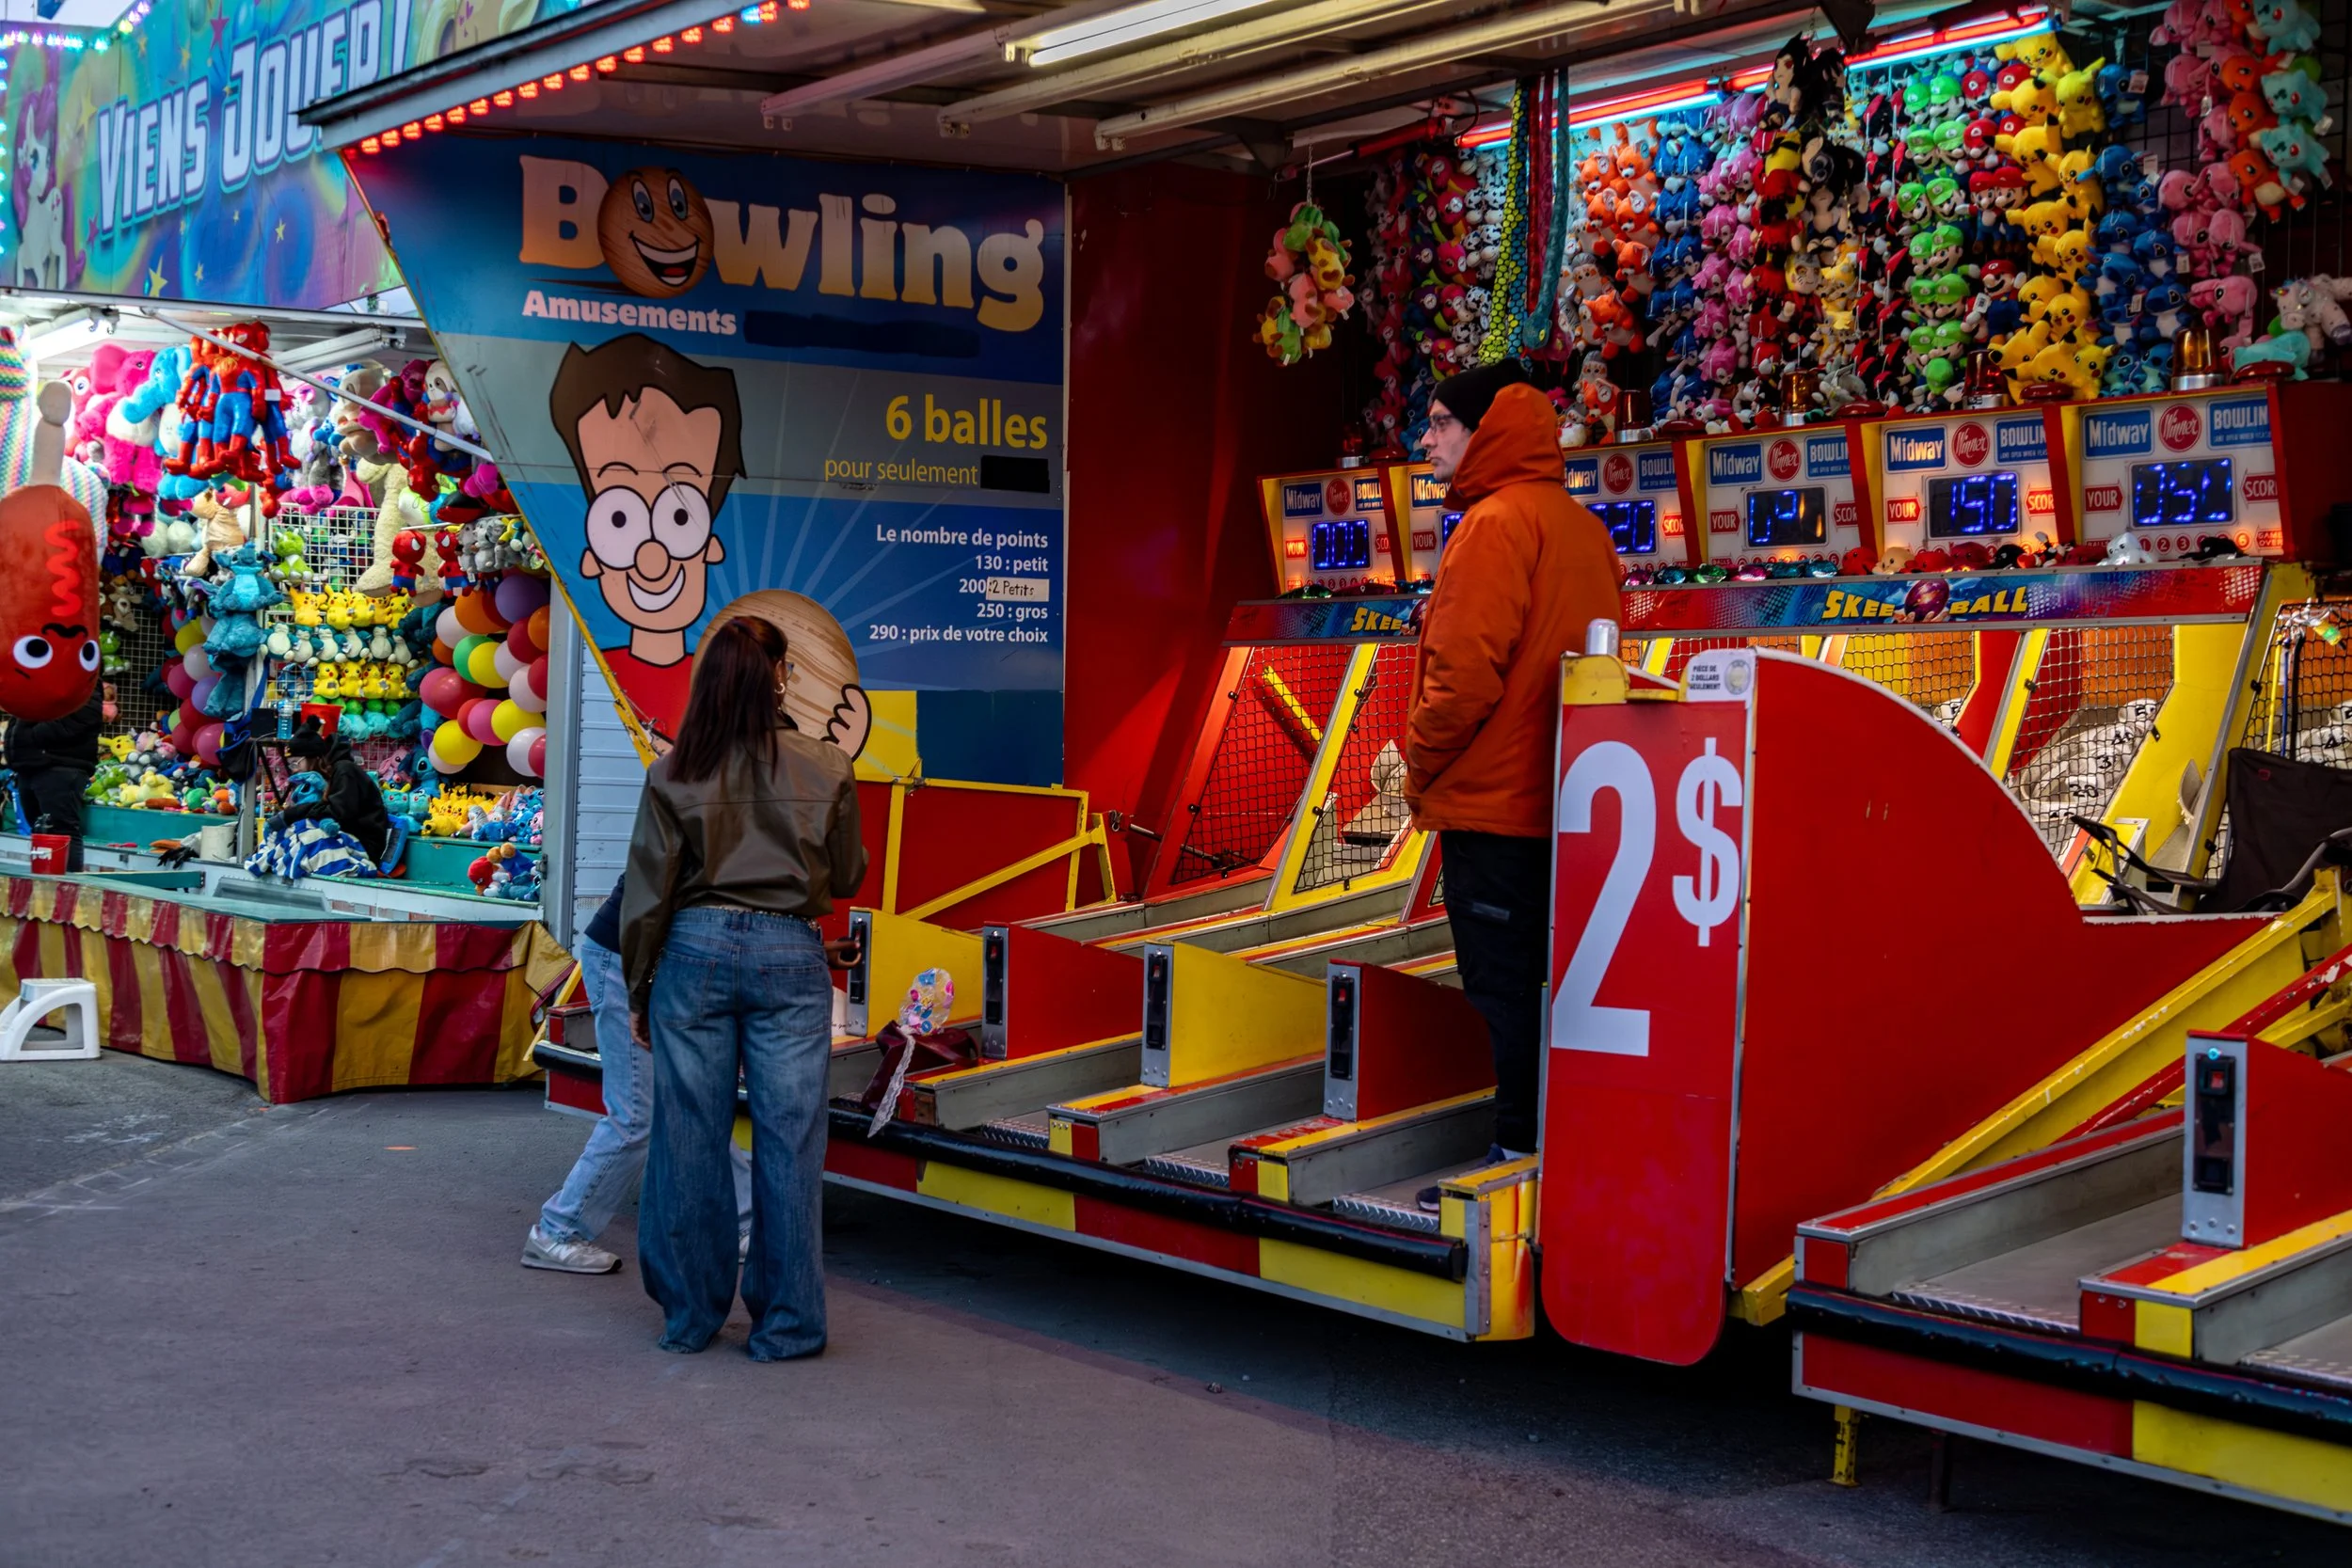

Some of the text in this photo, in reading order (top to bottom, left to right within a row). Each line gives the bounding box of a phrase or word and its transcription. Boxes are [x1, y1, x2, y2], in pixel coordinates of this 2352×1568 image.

[99, 79, 208, 235] VIENS
[522, 290, 738, 336] Amusements
[885, 393, 1048, 450] 6 balles
[2089, 420, 2149, 448] Midway
[1890, 436, 1943, 463] Midway
[824, 458, 978, 485] pour seulement
[1712, 451, 1760, 476] Midway
[1565, 467, 1597, 489] idway
[1286, 487, 1322, 510] Midway
[1888, 501, 1916, 518] YOUR
[1950, 473, 2017, 532] 150
[2087, 491, 2118, 507] YOUR
[1711, 514, 1737, 530] YOUR
[876, 524, 1048, 550] Le nombre de points
[1376, 536, 1391, 550] SCO
[1413, 534, 1434, 548] YOUR
[2159, 539, 2168, 550] 2
[2179, 538, 2187, 548] 3
[2238, 534, 2246, 545] 6
[1286, 541, 1305, 556] YOUR
[975, 555, 1002, 571] 130
[1013, 556, 1048, 574] petit
[959, 578, 986, 594] 200
[977, 603, 1005, 618] 250
[1015, 606, 1048, 623] gros
[1821, 585, 2029, 619] SKEE BALL
[1350, 607, 1403, 632] SKEE
[869, 625, 898, 641] 290
[909, 626, 940, 643] prix
[943, 626, 962, 641] de
[965, 628, 1005, 641] votre
[1008, 626, 1048, 642] choix
